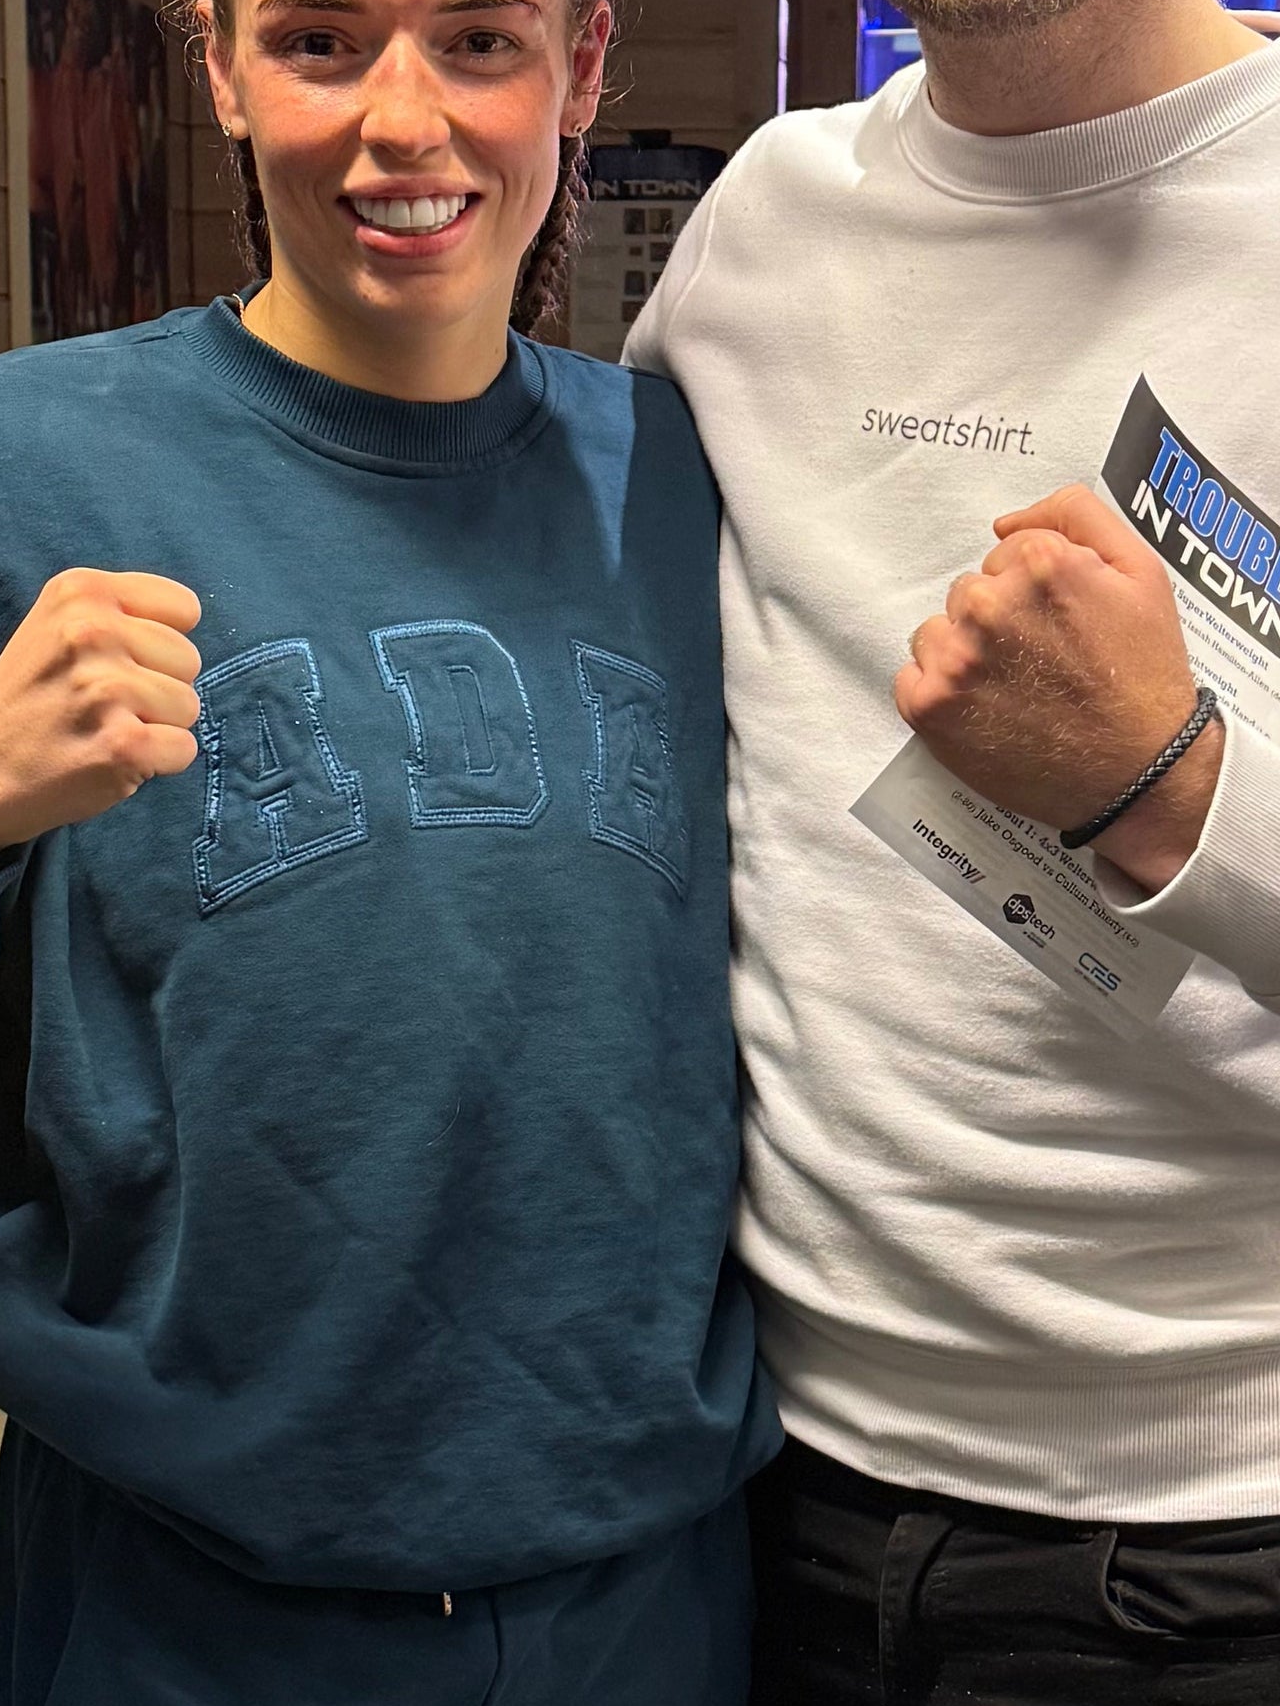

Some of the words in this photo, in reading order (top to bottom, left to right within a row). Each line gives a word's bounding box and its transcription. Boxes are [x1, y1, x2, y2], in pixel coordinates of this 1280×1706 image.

[861, 408, 1036, 456] sweatshirt.
[1130, 479, 1172, 543] IN
[911, 817, 978, 879] Integrity
[1001, 827, 1043, 867] Osgood
